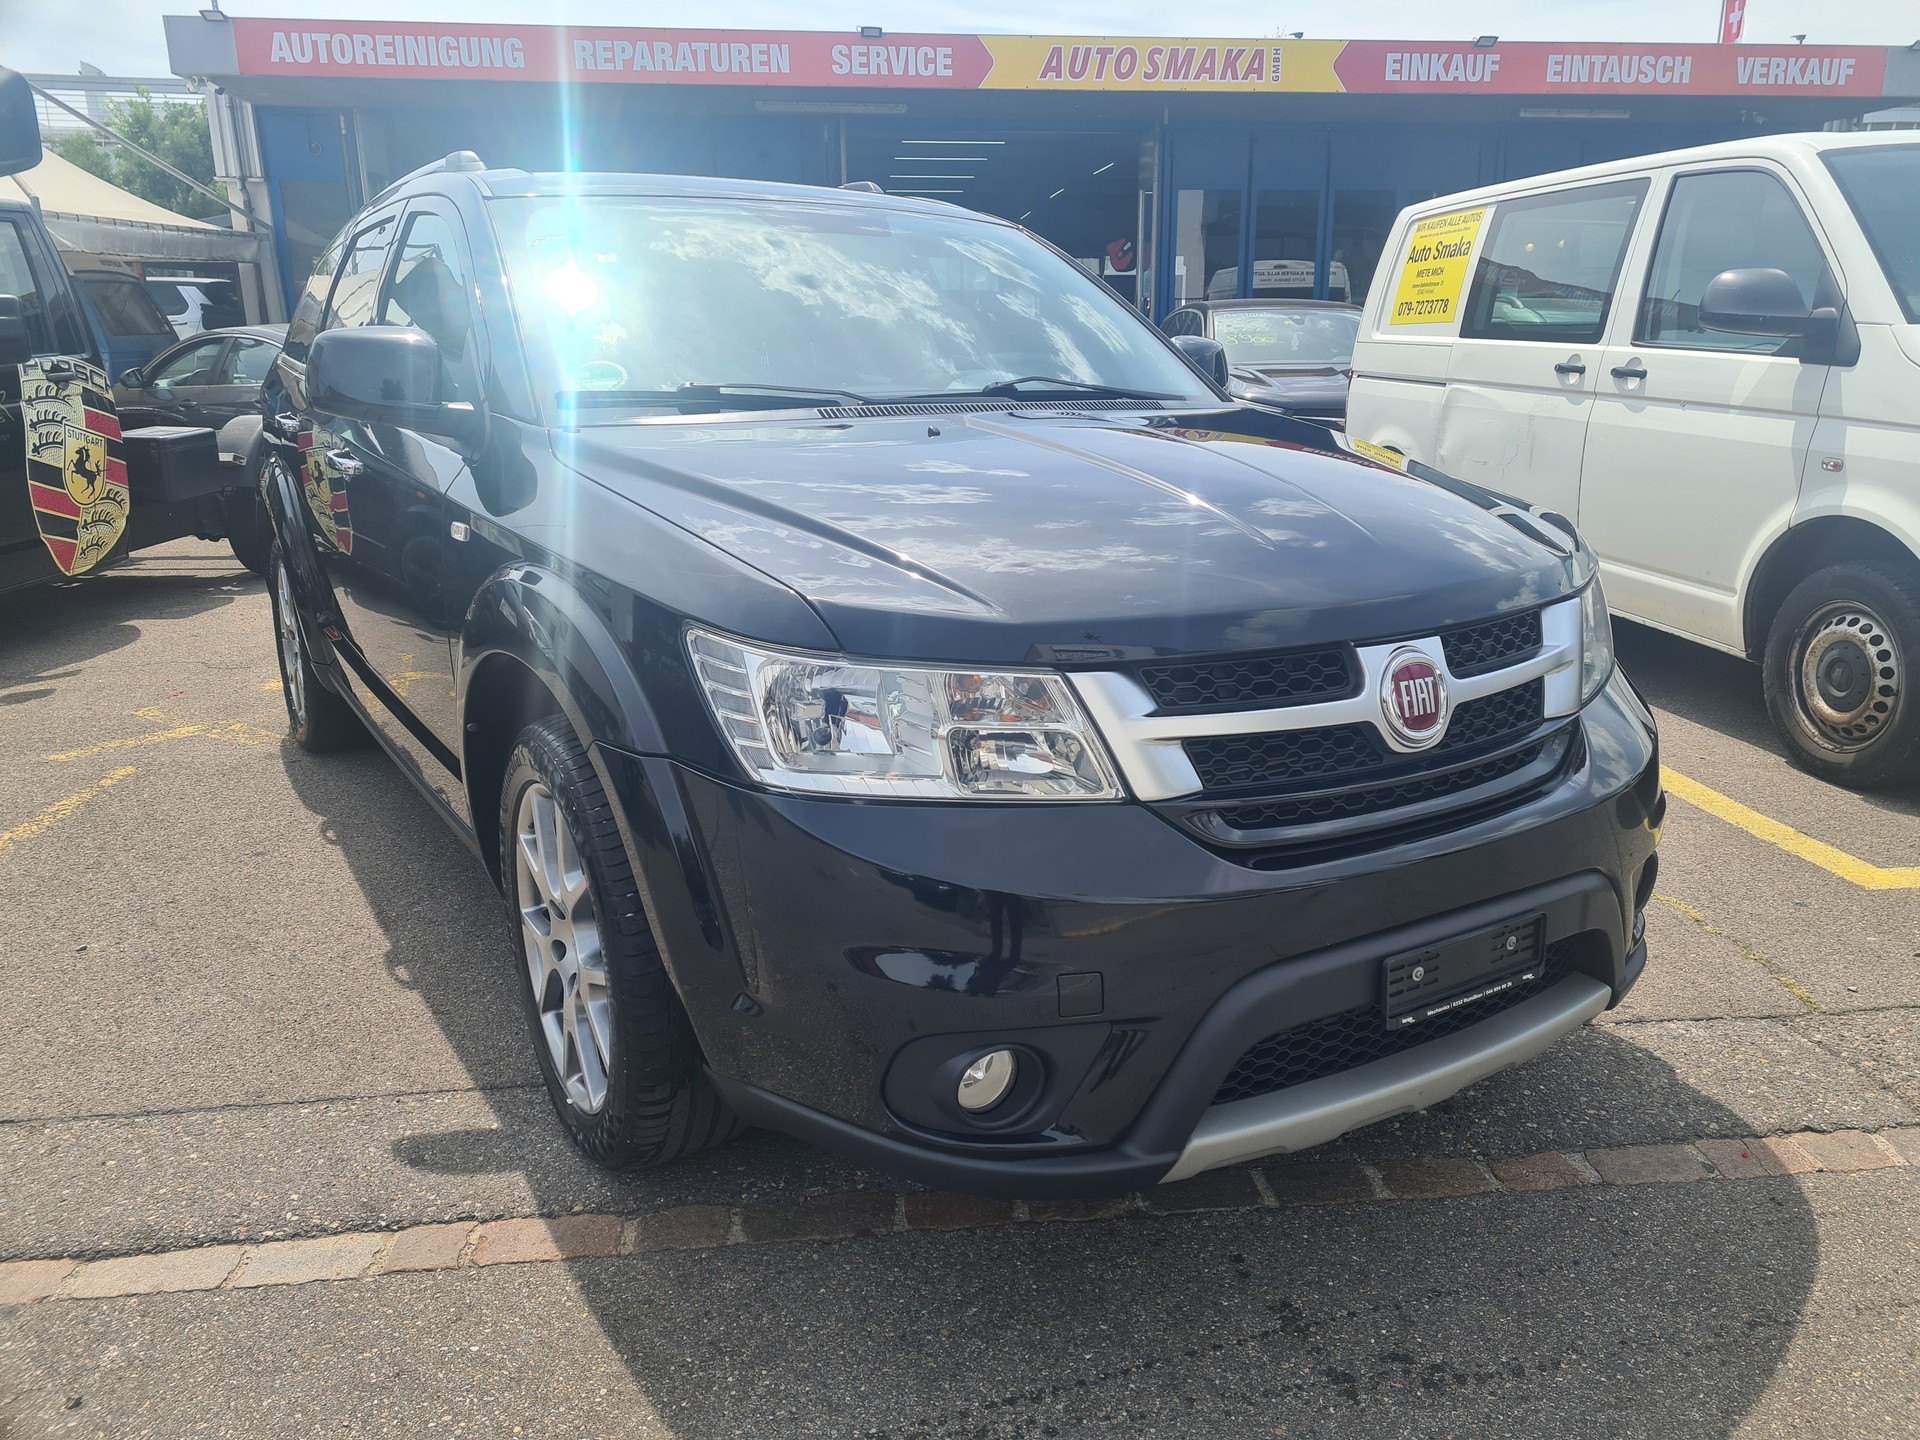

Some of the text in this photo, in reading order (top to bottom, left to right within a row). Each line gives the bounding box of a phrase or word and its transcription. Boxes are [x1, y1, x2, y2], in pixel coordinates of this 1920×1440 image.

[271, 32, 525, 68] AUTOREINIGUNG
[573, 40, 790, 73] REPARATUREN
[832, 45, 953, 76] SERVICE
[1038, 45, 1265, 83] AUTO SMAKA
[1271, 47, 1281, 84] GMBH
[1385, 53, 1500, 82] EINKAUF
[1546, 55, 1692, 84] EINTAUSCH
[1736, 57, 1856, 86] VERKAUF
[1416, 212, 1483, 232] WIR KAUFEN ALLE AUTOS
[1407, 236, 1471, 264] Auto Smaka
[1416, 267, 1445, 278] MIETE MICH
[1398, 298, 1449, 316] 079-7273778
[67, 429, 103, 448] STUTTGART
[1400, 677, 1435, 718] FIAT
